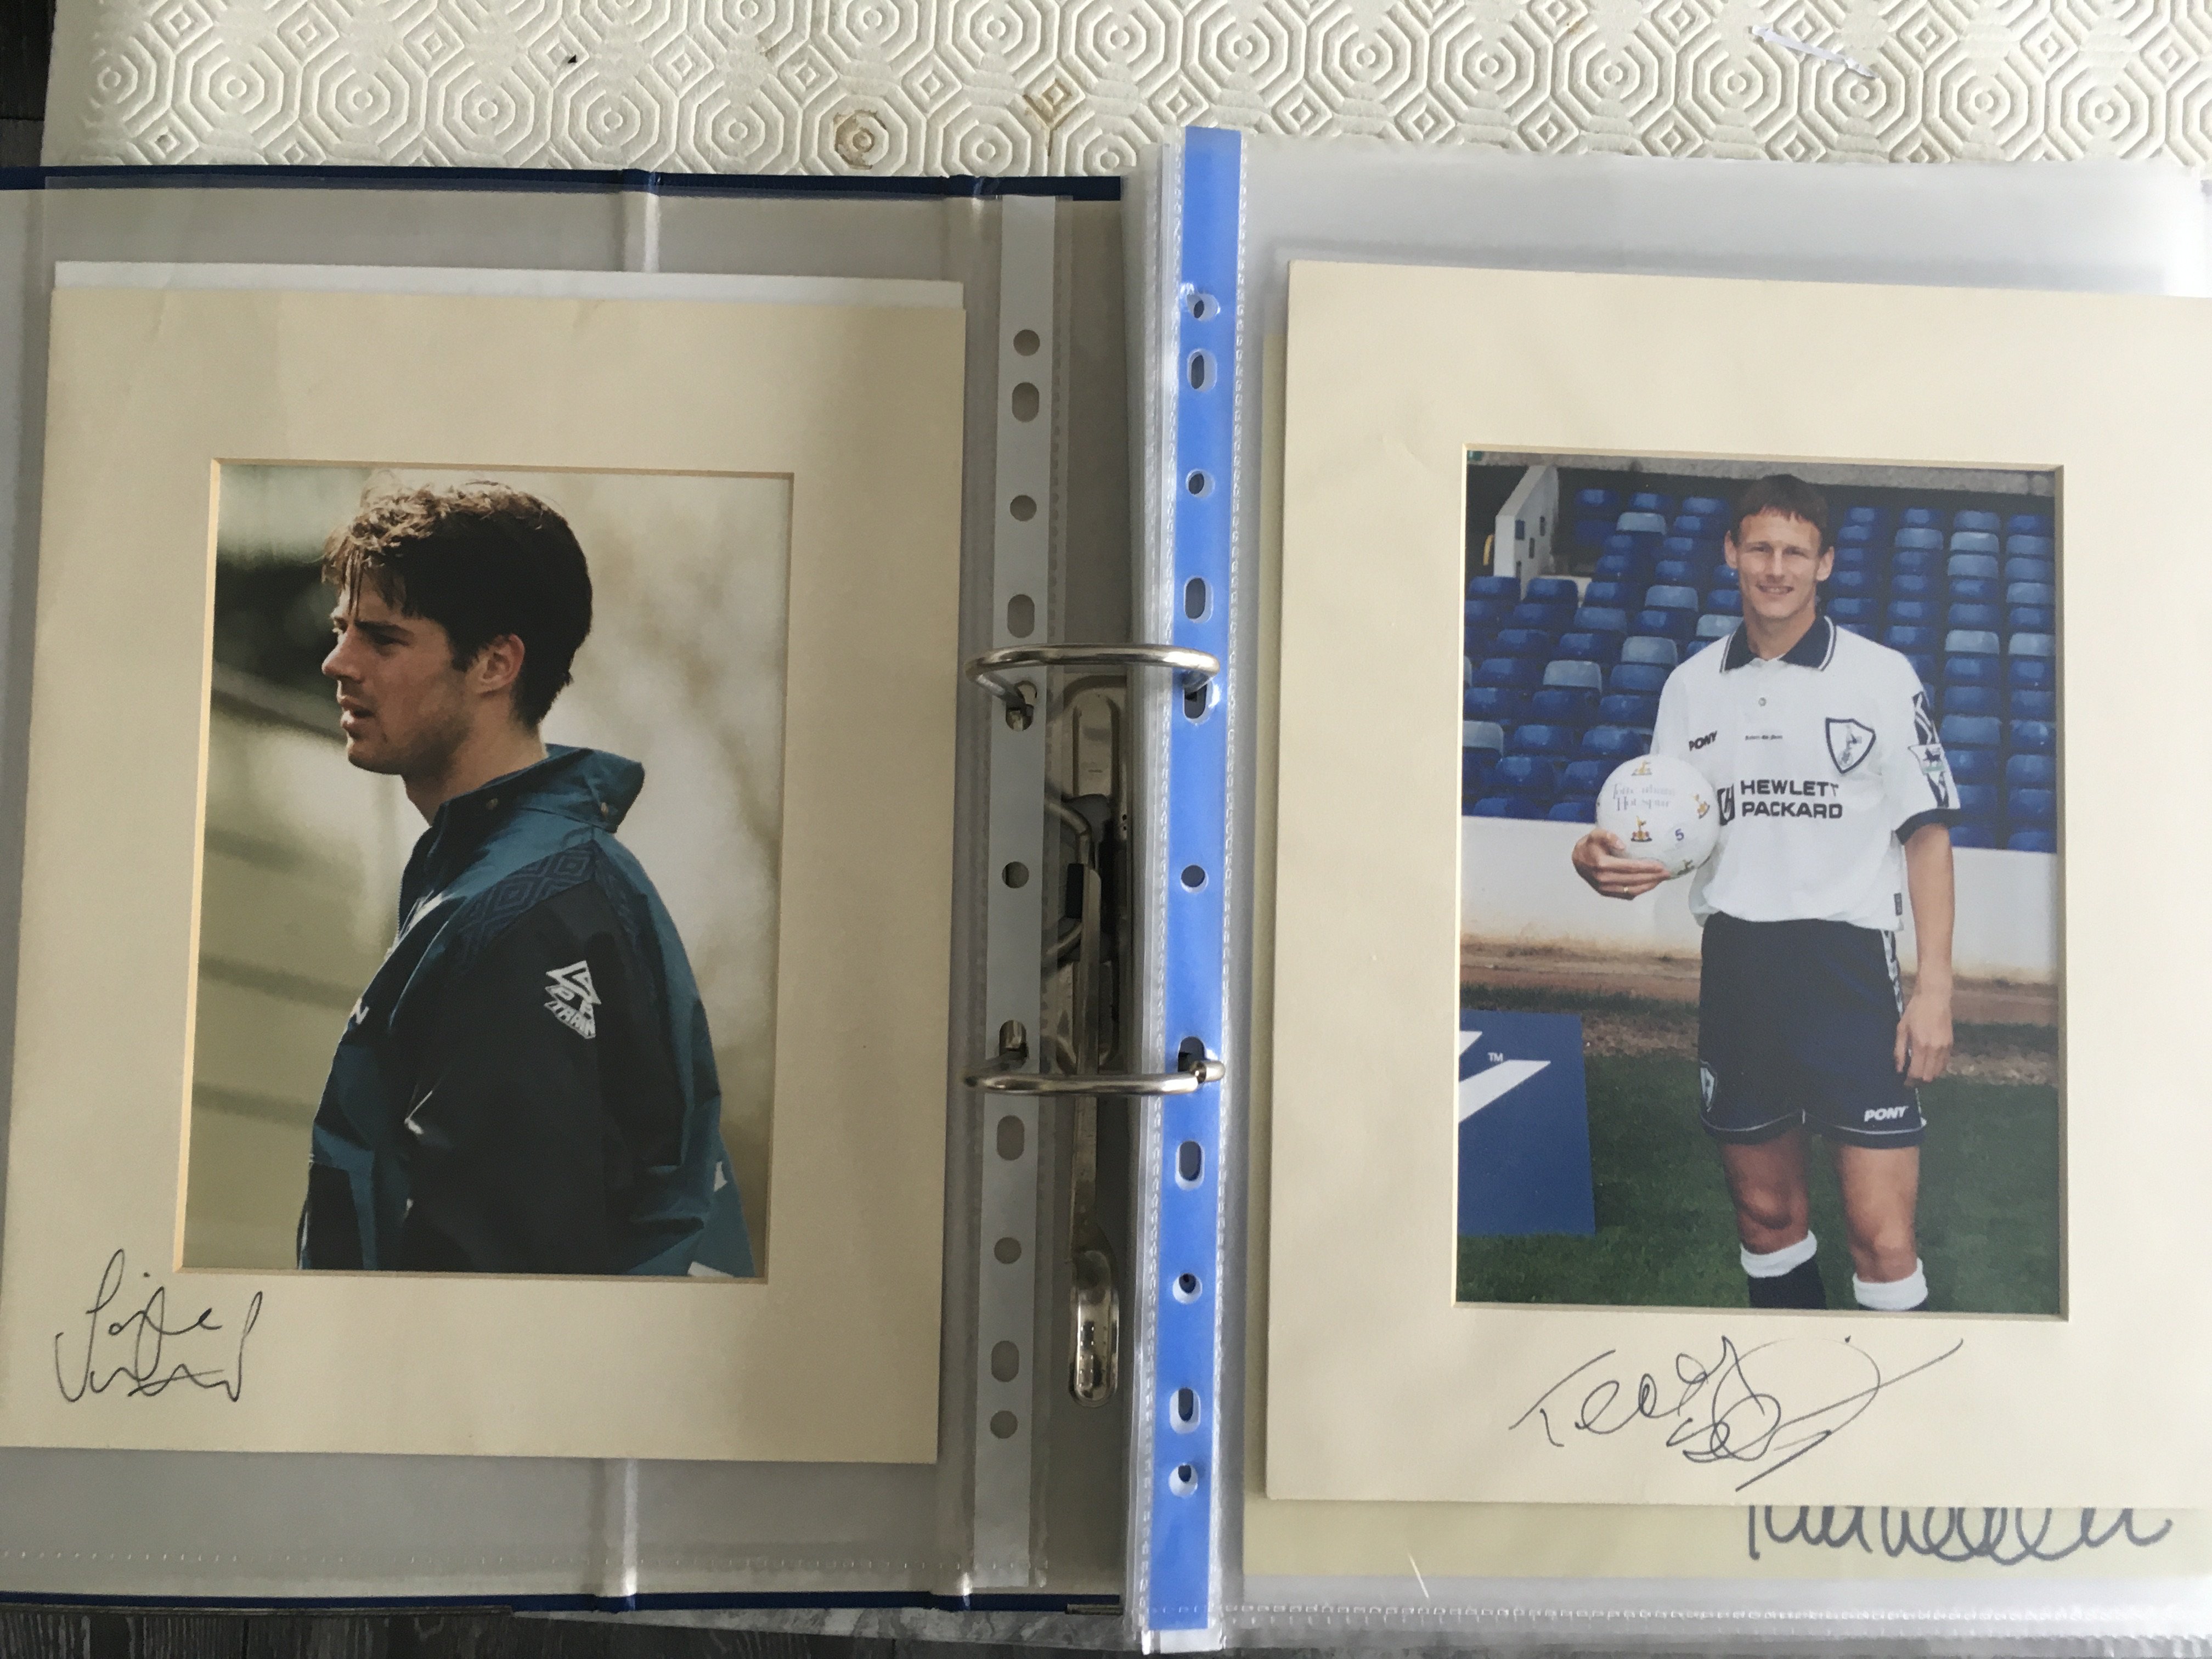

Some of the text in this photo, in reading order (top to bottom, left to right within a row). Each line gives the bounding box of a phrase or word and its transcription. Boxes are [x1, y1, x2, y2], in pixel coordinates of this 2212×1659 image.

[1689, 730, 1718, 752] PONY
[1740, 779, 1839, 797] HEWLETT
[1742, 801, 1843, 819] PACKARD
[1674, 828, 1684, 841] 5
[1487, 1052, 1504, 1063] TM
[1864, 1105, 1909, 1122] PONY
